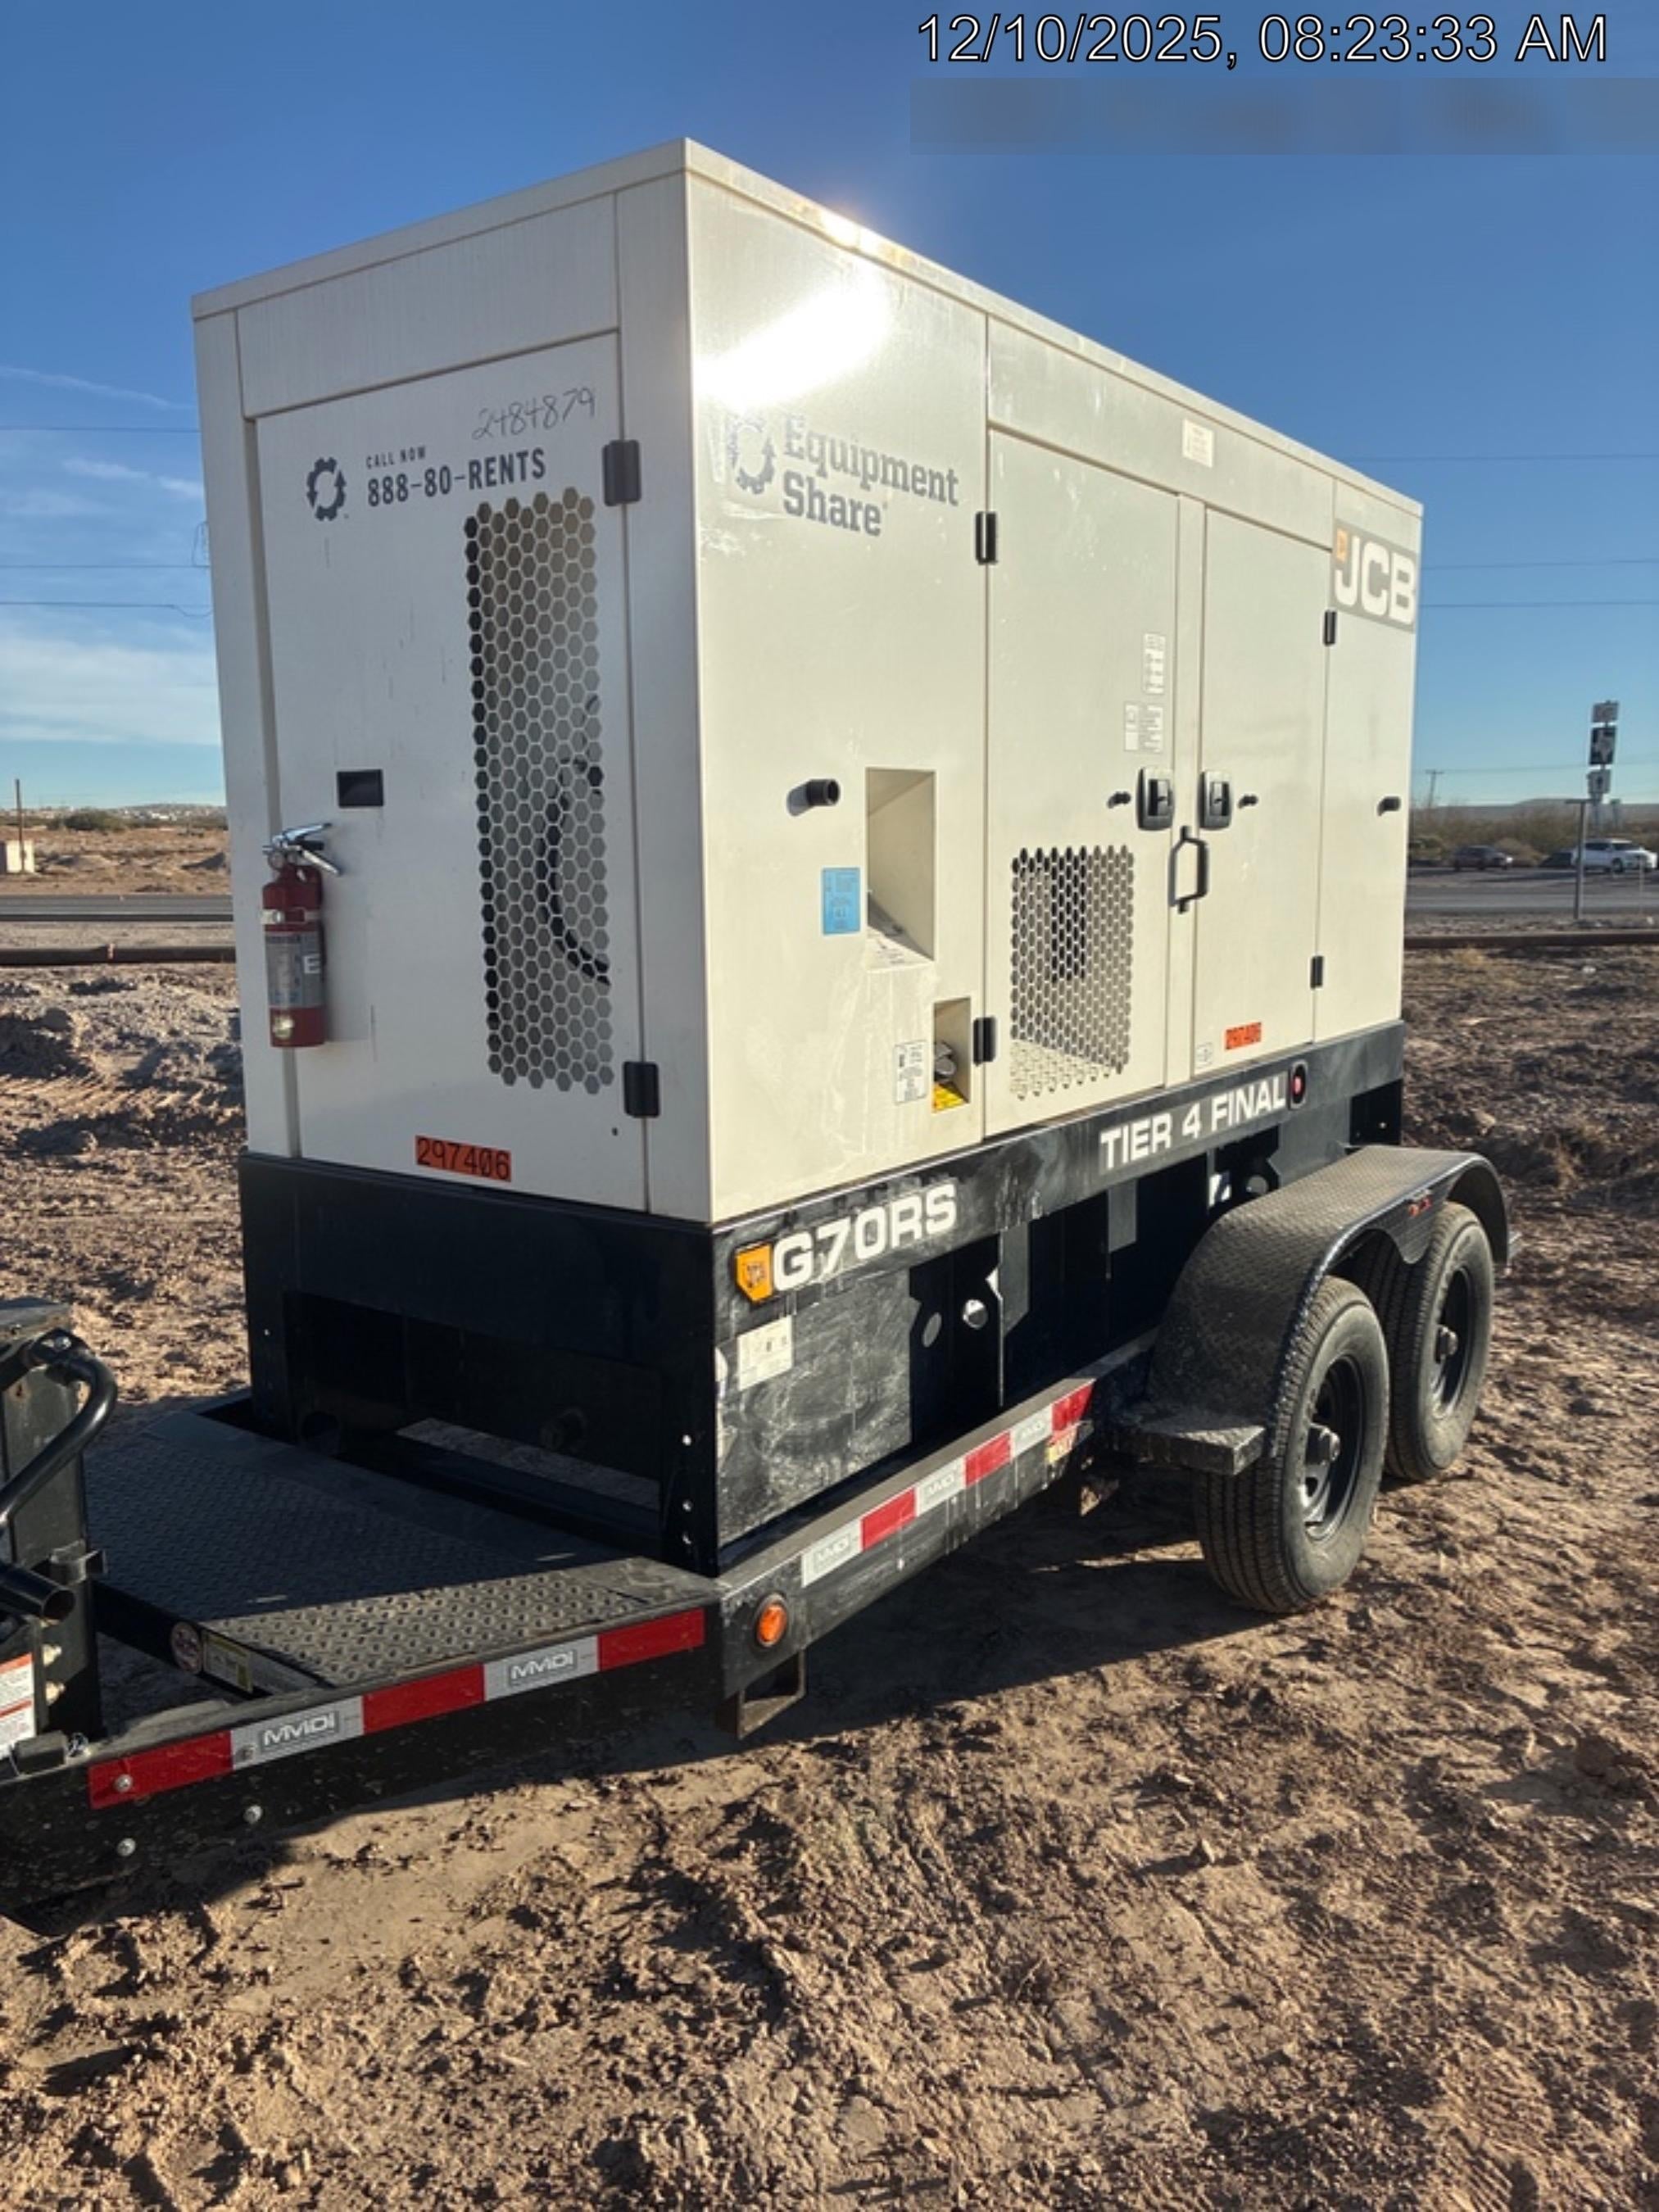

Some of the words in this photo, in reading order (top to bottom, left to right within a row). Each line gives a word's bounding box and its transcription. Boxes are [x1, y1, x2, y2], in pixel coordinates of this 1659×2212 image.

[366, 450, 395, 469] CALL
[400, 446, 427, 462] NOW
[366, 447, 547, 508] 888-80-RENTS
[783, 414, 959, 506] Equipment
[782, 469, 882, 537] Share
[1335, 535, 1416, 625] JCB
[416, 1137, 510, 1181] 297406
[1100, 1113, 1172, 1170] TIER
[1181, 1103, 1201, 1140] 4
[1211, 1076, 1287, 1132] FINAL
[773, 1184, 957, 1292] G70RS
